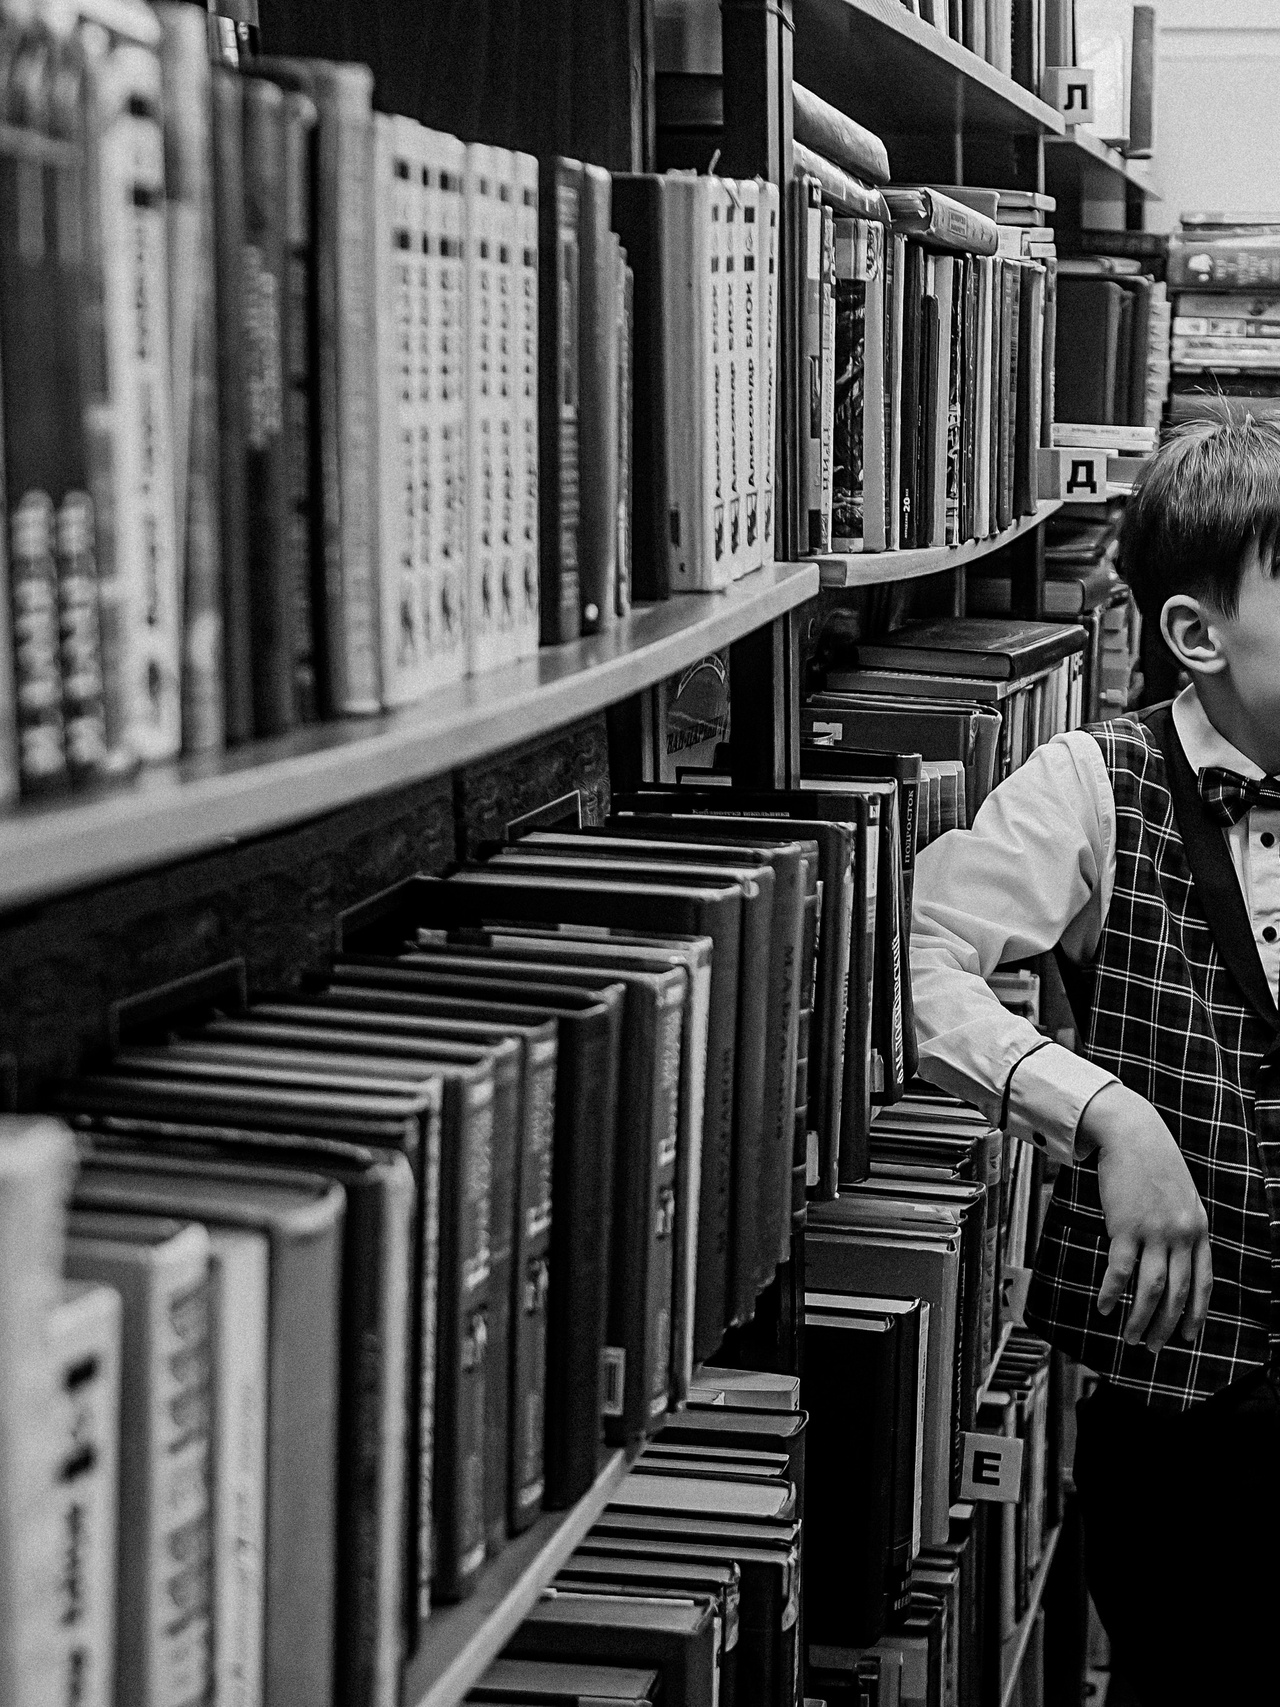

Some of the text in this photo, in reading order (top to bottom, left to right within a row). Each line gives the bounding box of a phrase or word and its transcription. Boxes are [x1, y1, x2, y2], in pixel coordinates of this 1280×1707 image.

[1063, 83, 1088, 111] Л
[745, 281, 756, 488] Александр БЛОК
[1066, 459, 1097, 494] Д
[904, 790, 915, 864] ПОДРОСТОК
[972, 1449, 1003, 1487] Е
